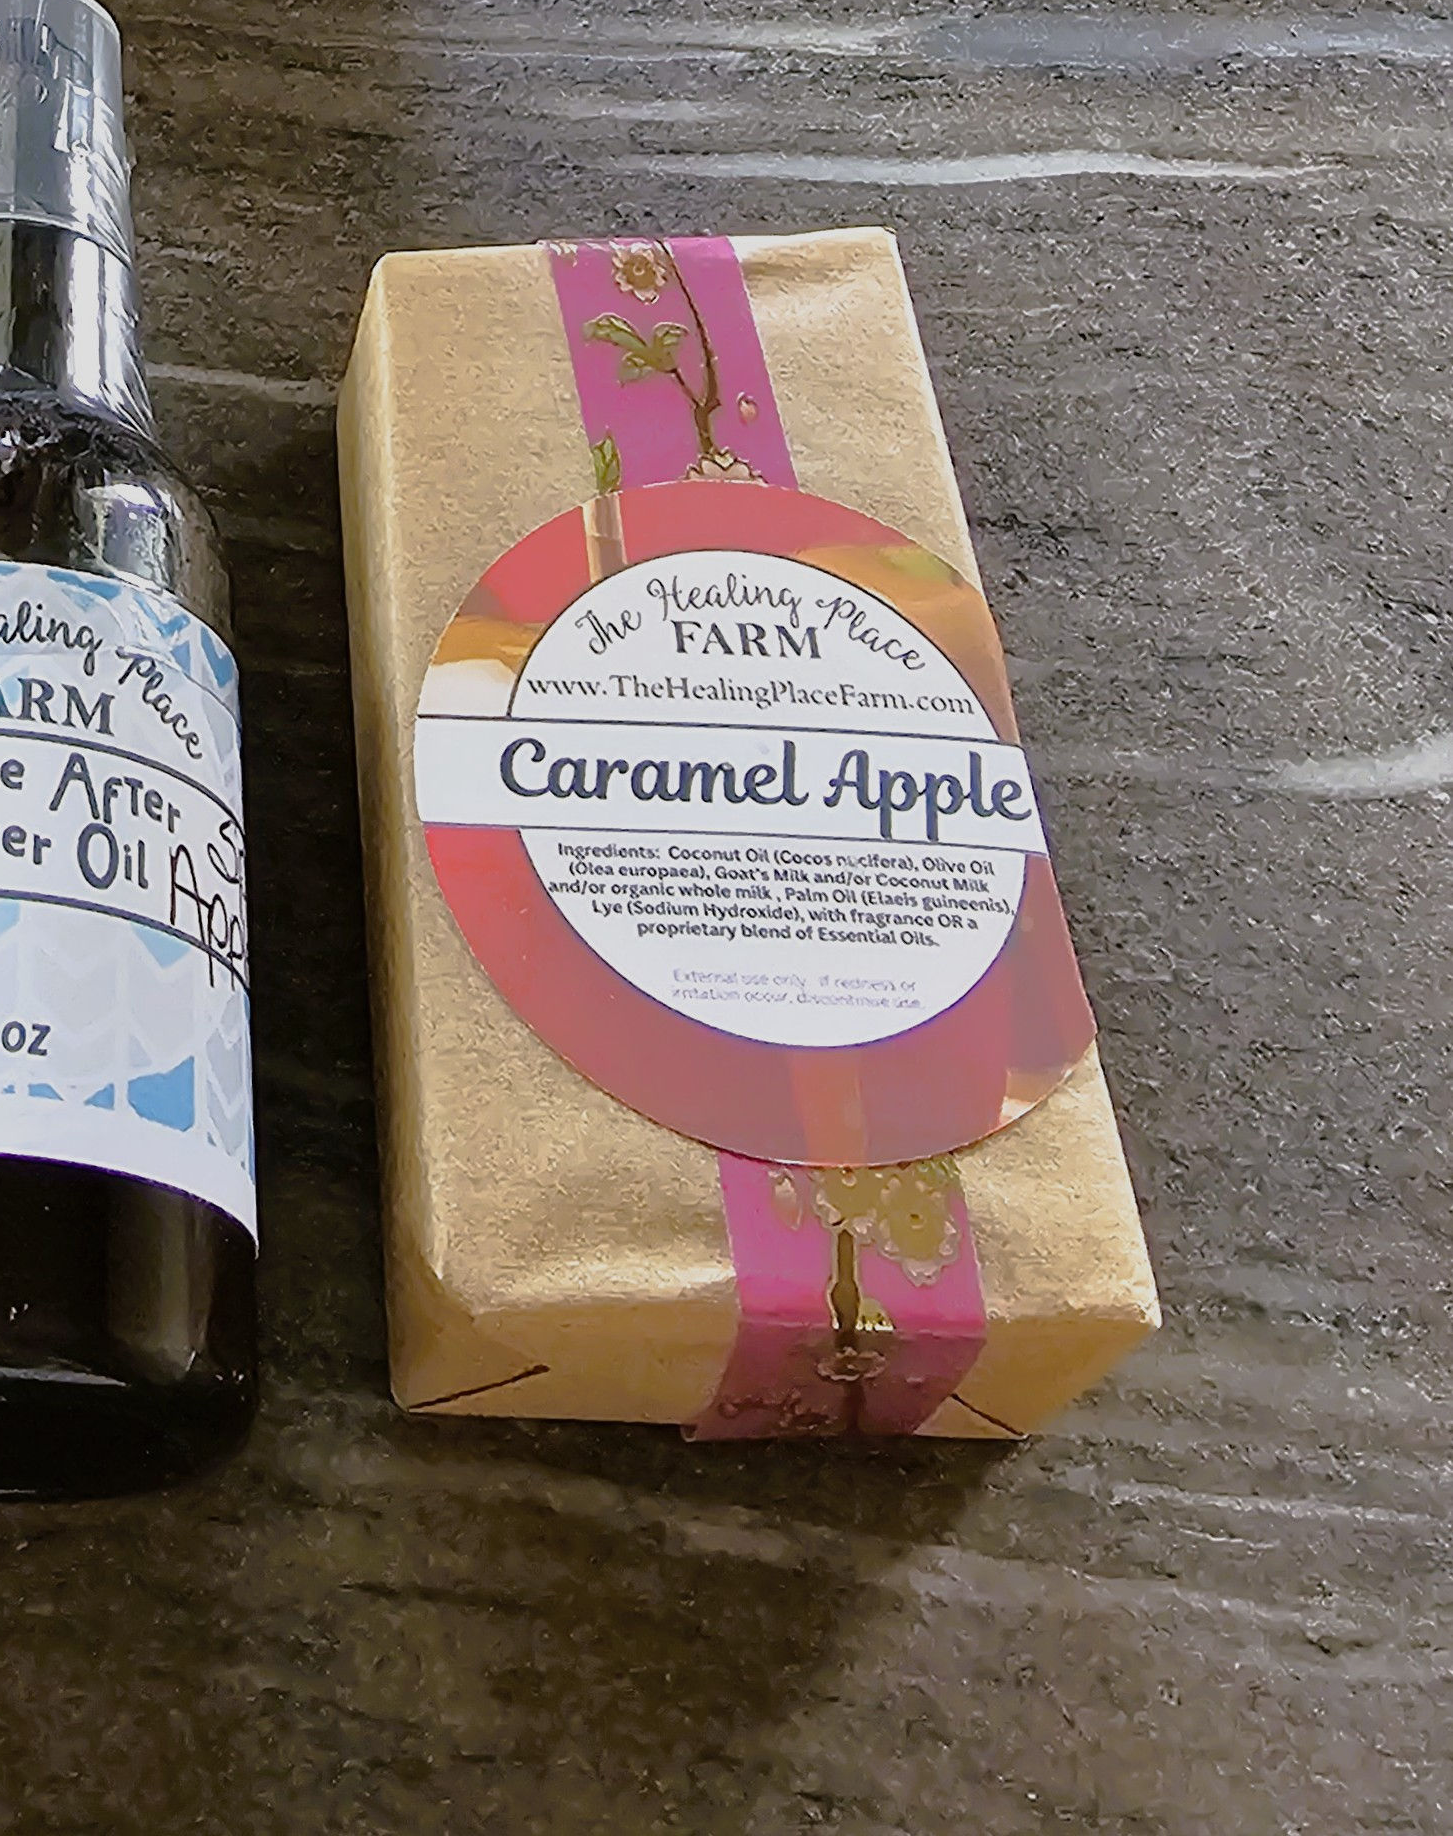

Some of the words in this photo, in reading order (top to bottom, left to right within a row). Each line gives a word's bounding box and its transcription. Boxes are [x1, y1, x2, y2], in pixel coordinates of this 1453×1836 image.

[574, 601, 643, 657] The
[647, 572, 803, 629] Healing
[814, 592, 927, 672] Place
[671, 620, 823, 661] FARM
[114, 644, 204, 760] Place
[526, 674, 976, 718] www.TheHealingPlaceFarm.com
[498, 735, 810, 808] Caramel
[822, 749, 1034, 843] Apple
[76, 821, 149, 891] Oil
[558, 842, 661, 861] Ingredients:
[668, 845, 742, 863] Coconut
[746, 847, 770, 864] Oil
[773, 849, 833, 867] (Cocos
[921, 856, 966, 874] Olive
[970, 859, 996, 876] Oil
[548, 879, 606, 895] and/or
[611, 882, 676, 900] organic
[678, 884, 731, 899] whole
[785, 887, 828, 903] Palm
[832, 889, 858, 905] Oil
[569, 861, 614, 877] (Olea
[714, 865, 770, 882] Goat's
[773, 868, 809, 884] Milk
[813, 871, 871, 887] and/or
[875, 872, 951, 891] Coconut
[953, 877, 990, 893] Milk
[591, 899, 623, 917] Lye
[627, 901, 698, 917] (Sodium
[809, 908, 847, 923] with
[850, 909, 934, 929] fragrance
[938, 913, 963, 929] OR
[967, 918, 979, 931] a
[637, 921, 737, 942] proprietary
[740, 924, 792, 940] blend
[795, 926, 814, 941] of
[818, 927, 897, 945] Essential
[900, 931, 941, 947] Oils.
[0, 1020, 52, 1057] oz
